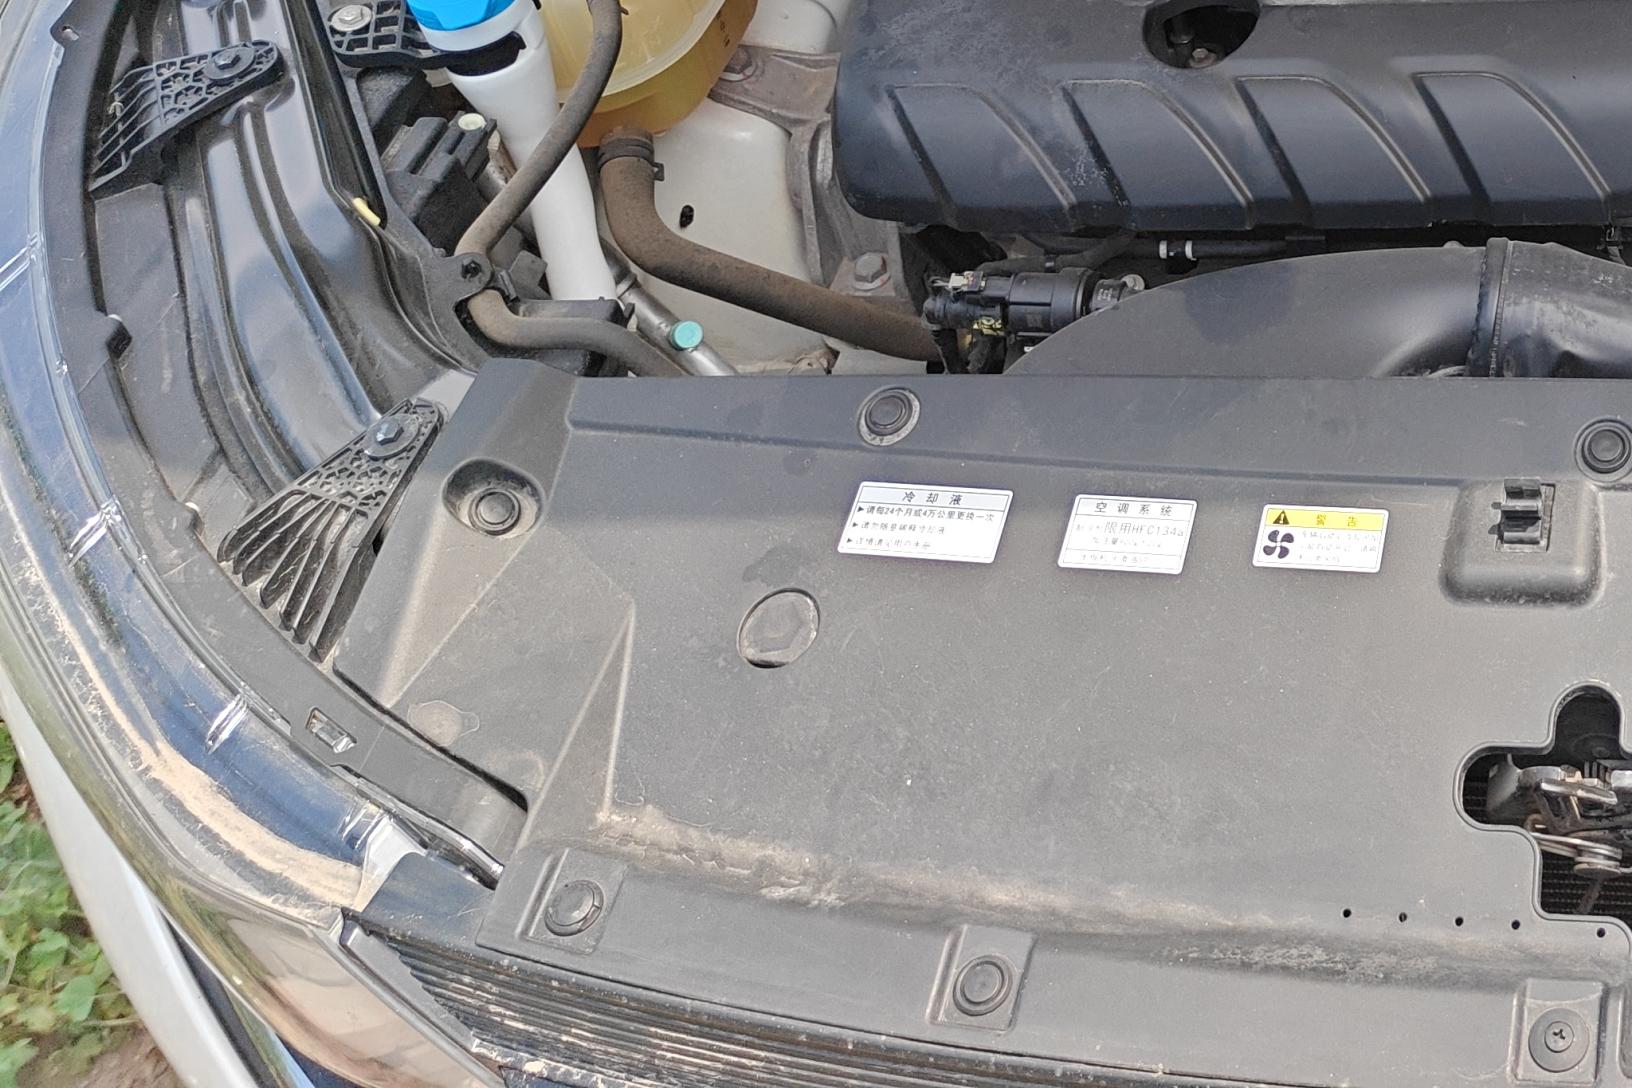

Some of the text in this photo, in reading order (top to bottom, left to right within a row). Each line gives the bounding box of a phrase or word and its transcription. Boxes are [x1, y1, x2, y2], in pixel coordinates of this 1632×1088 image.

[902, 491, 963, 505] 冷却液
[1095, 502, 1173, 517] 空调系统
